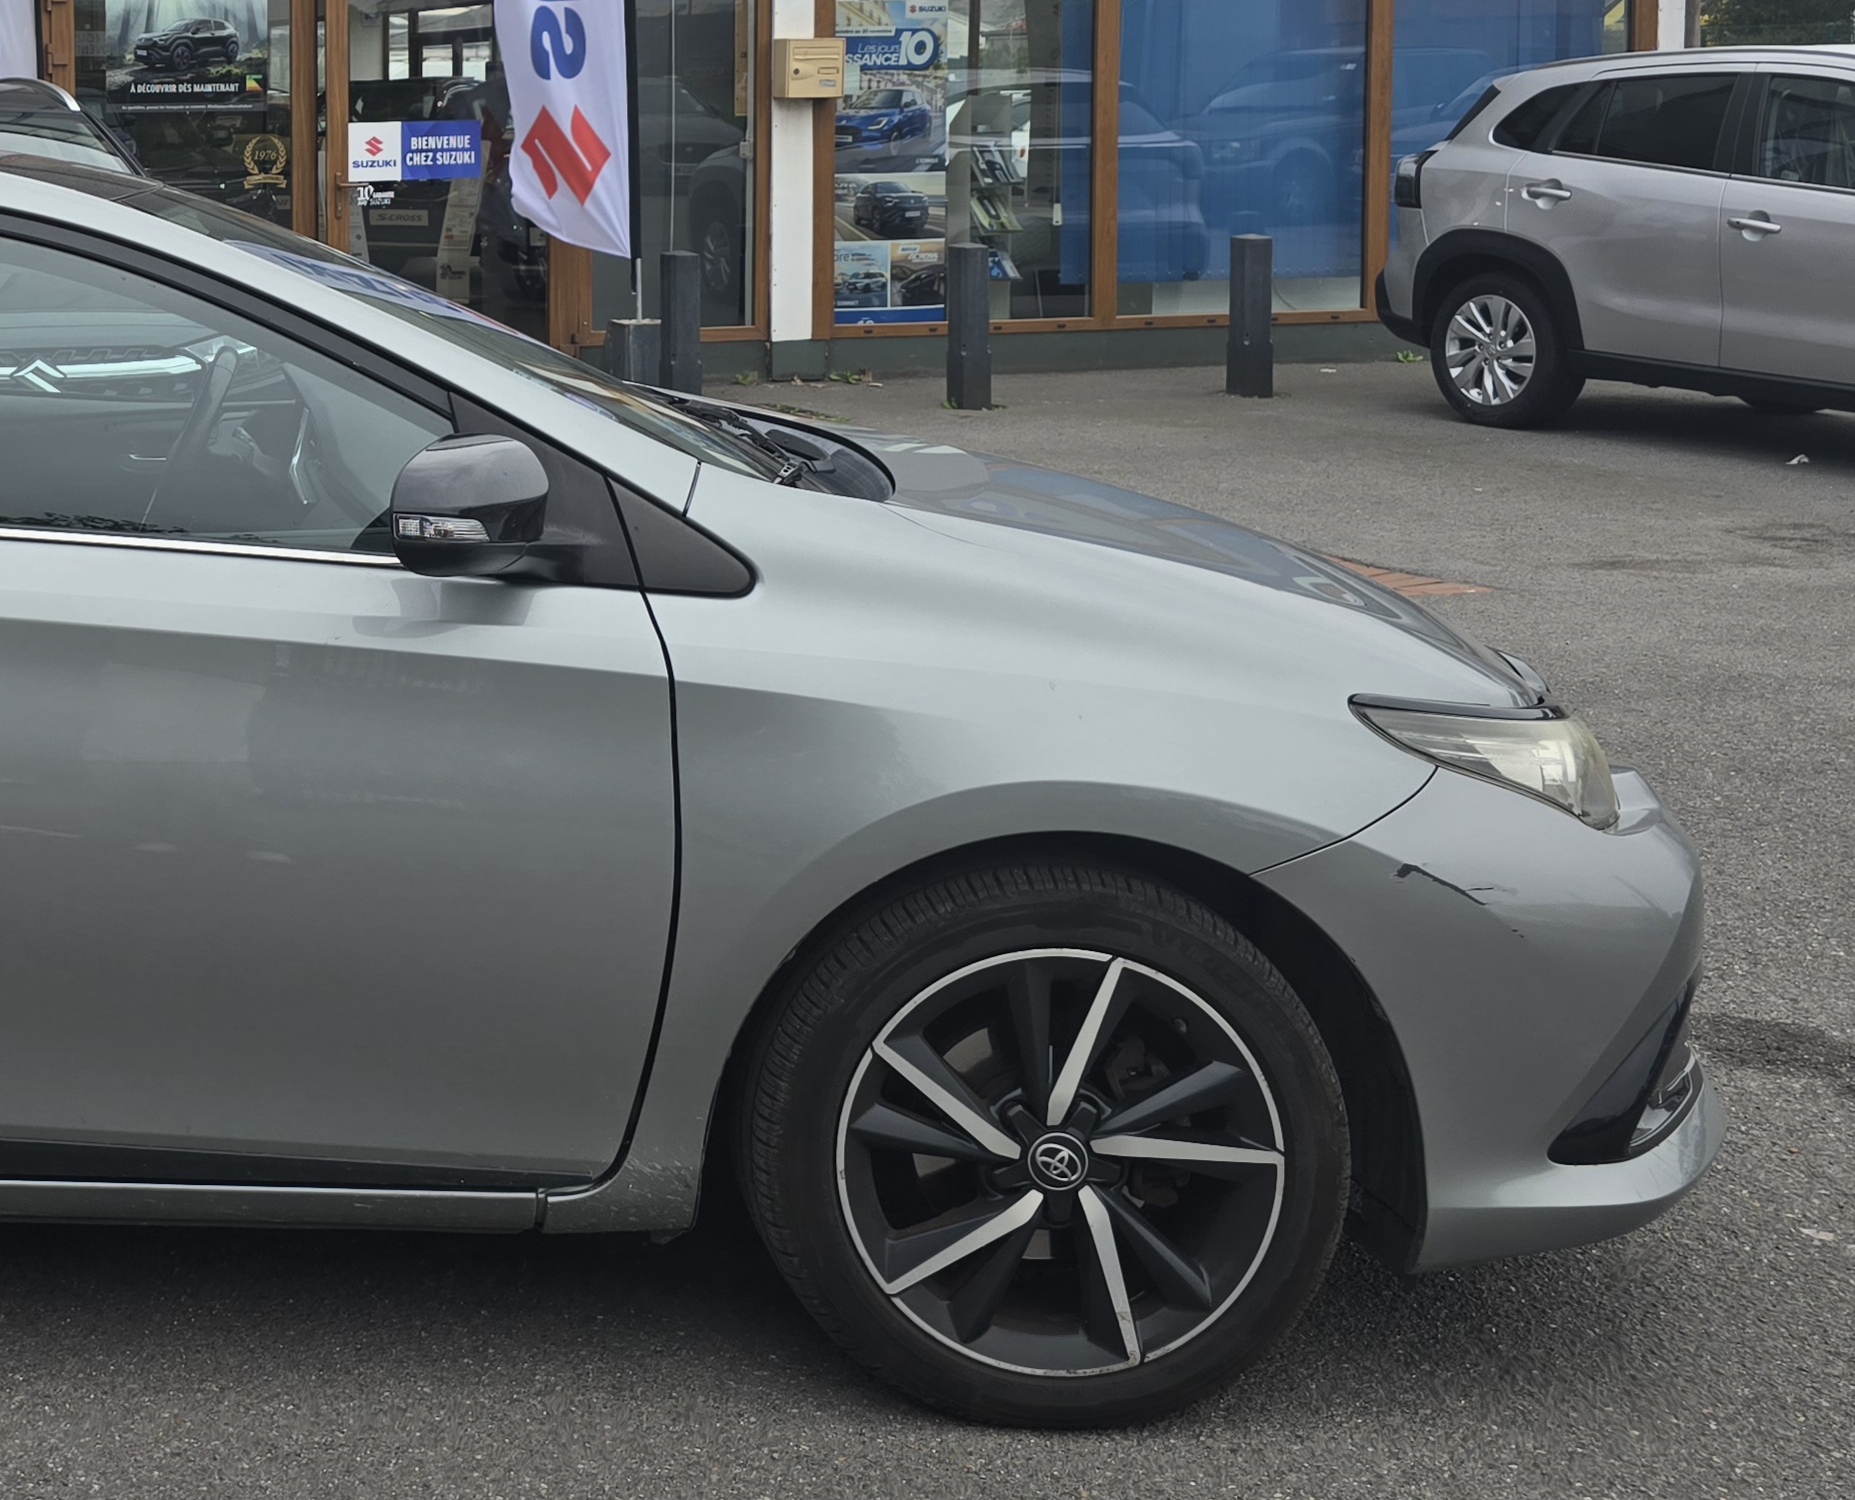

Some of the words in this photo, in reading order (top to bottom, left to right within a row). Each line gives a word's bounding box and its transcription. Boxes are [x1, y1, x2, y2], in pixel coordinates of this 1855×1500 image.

[845, 53, 900, 66] SSANCE
[898, 30, 934, 66] 10
[130, 82, 136, 93] À
[137, 82, 177, 93] DÉCOUVRIR
[178, 82, 192, 93] DÈS
[193, 83, 239, 92] MAINTENANT
[410, 135, 471, 150] BIENVENUE
[254, 150, 277, 160] 1976
[405, 152, 433, 167] CHEZ
[435, 151, 475, 165] SUZUKI
[352, 159, 397, 168] SUZUKI
